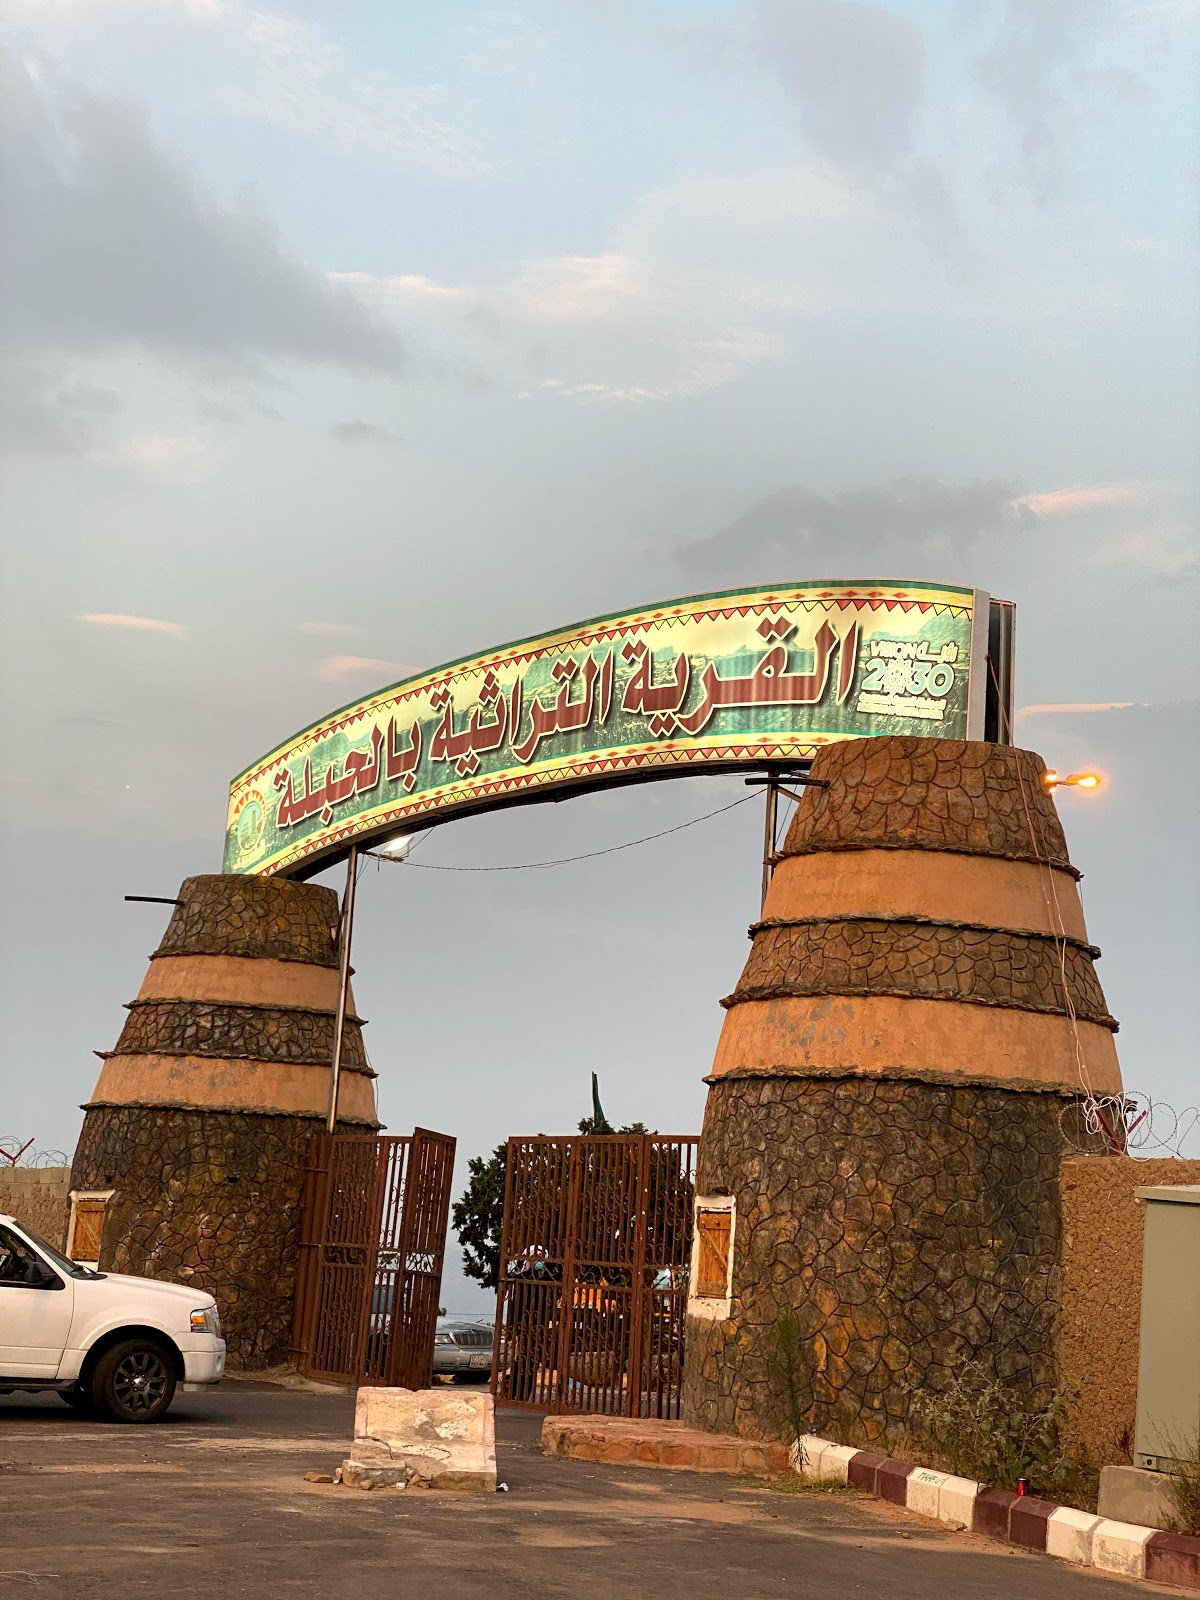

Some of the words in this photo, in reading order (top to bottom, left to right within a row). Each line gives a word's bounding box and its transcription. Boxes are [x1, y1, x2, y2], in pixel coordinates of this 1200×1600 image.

[621, 615, 858, 738] القرية
[870, 640, 919, 660] VISION
[428, 646, 614, 777] التراثية
[273, 715, 422, 828] بالحبلة
